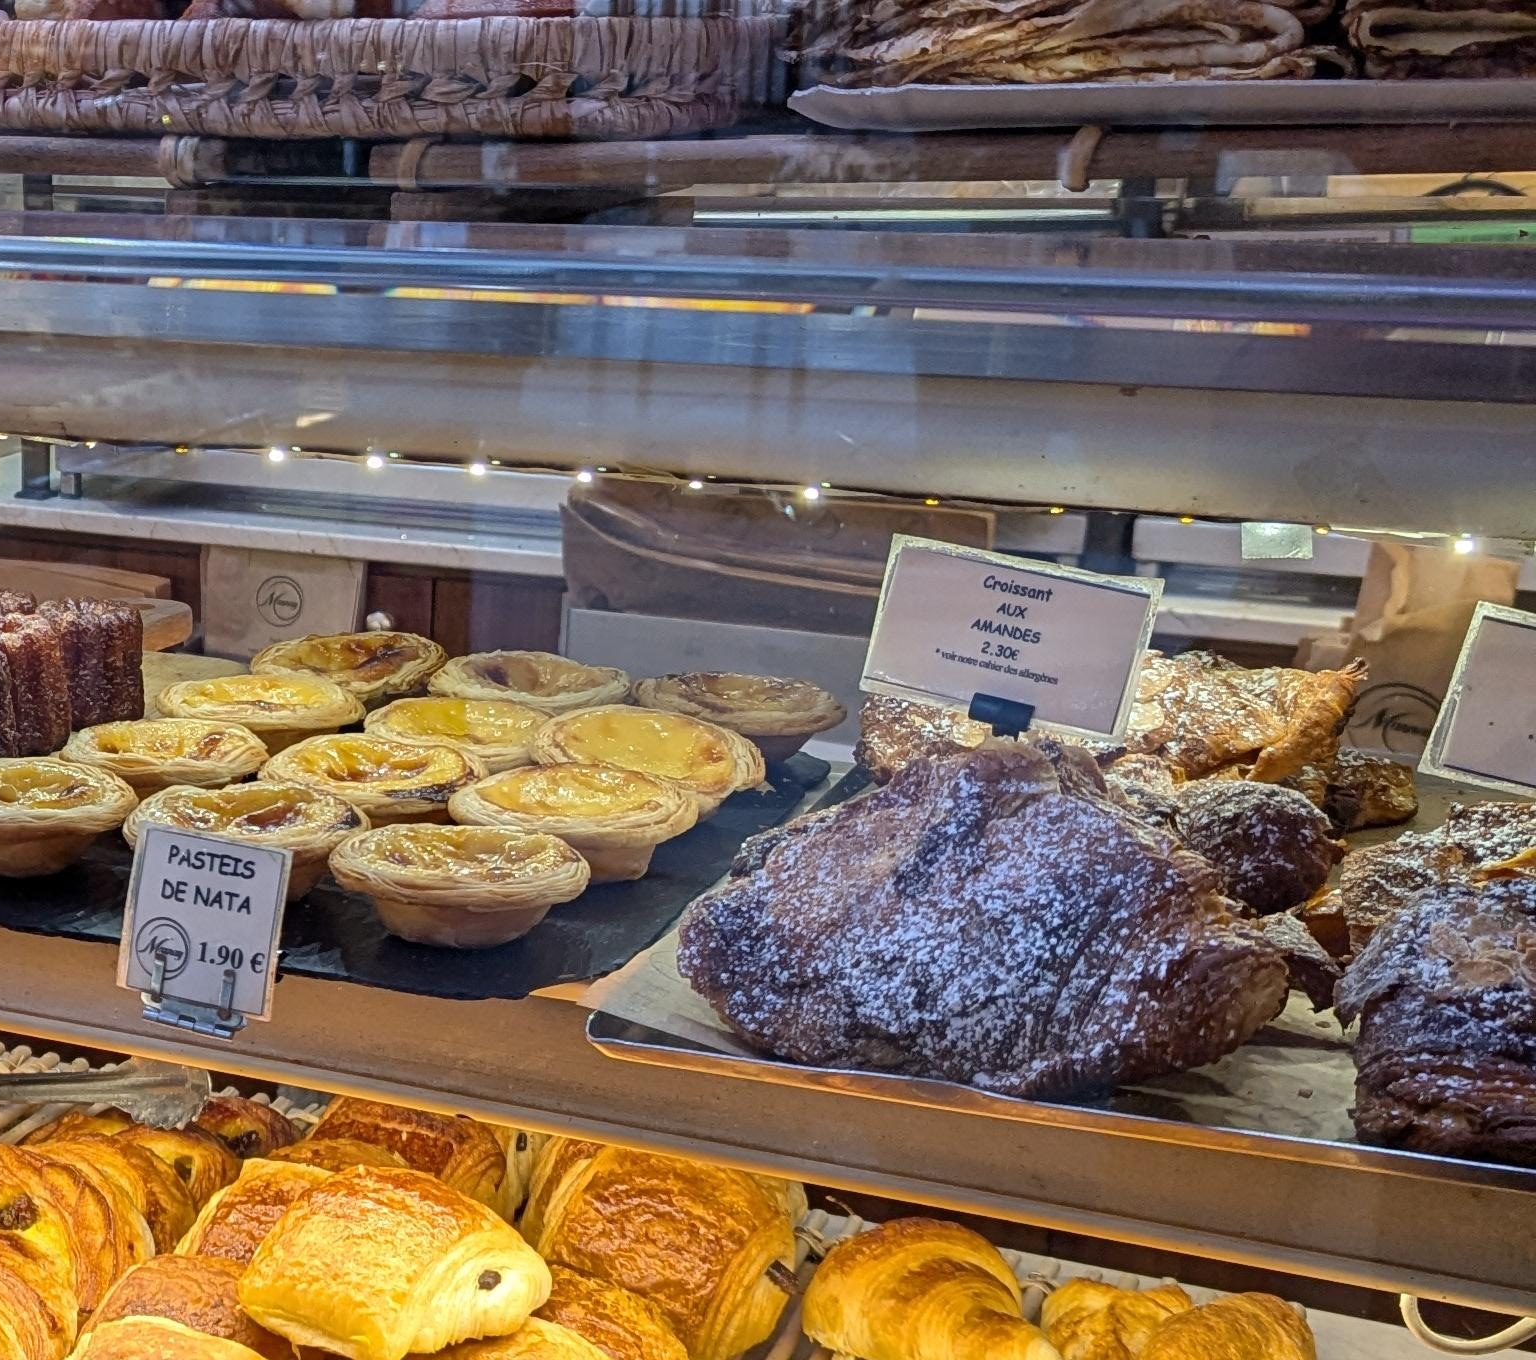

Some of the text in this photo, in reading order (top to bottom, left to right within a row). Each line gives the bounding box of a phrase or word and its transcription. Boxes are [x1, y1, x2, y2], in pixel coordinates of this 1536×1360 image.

[983, 575, 1054, 602] Croissant
[996, 602, 1028, 619] AUX
[970, 619, 1042, 644] AMANDES
[980, 641, 1020, 661] 2.30€
[168, 844, 256, 879] PASTEIS
[161, 878, 252, 915] DE NATA
[198, 941, 265, 974] 1.90 €
